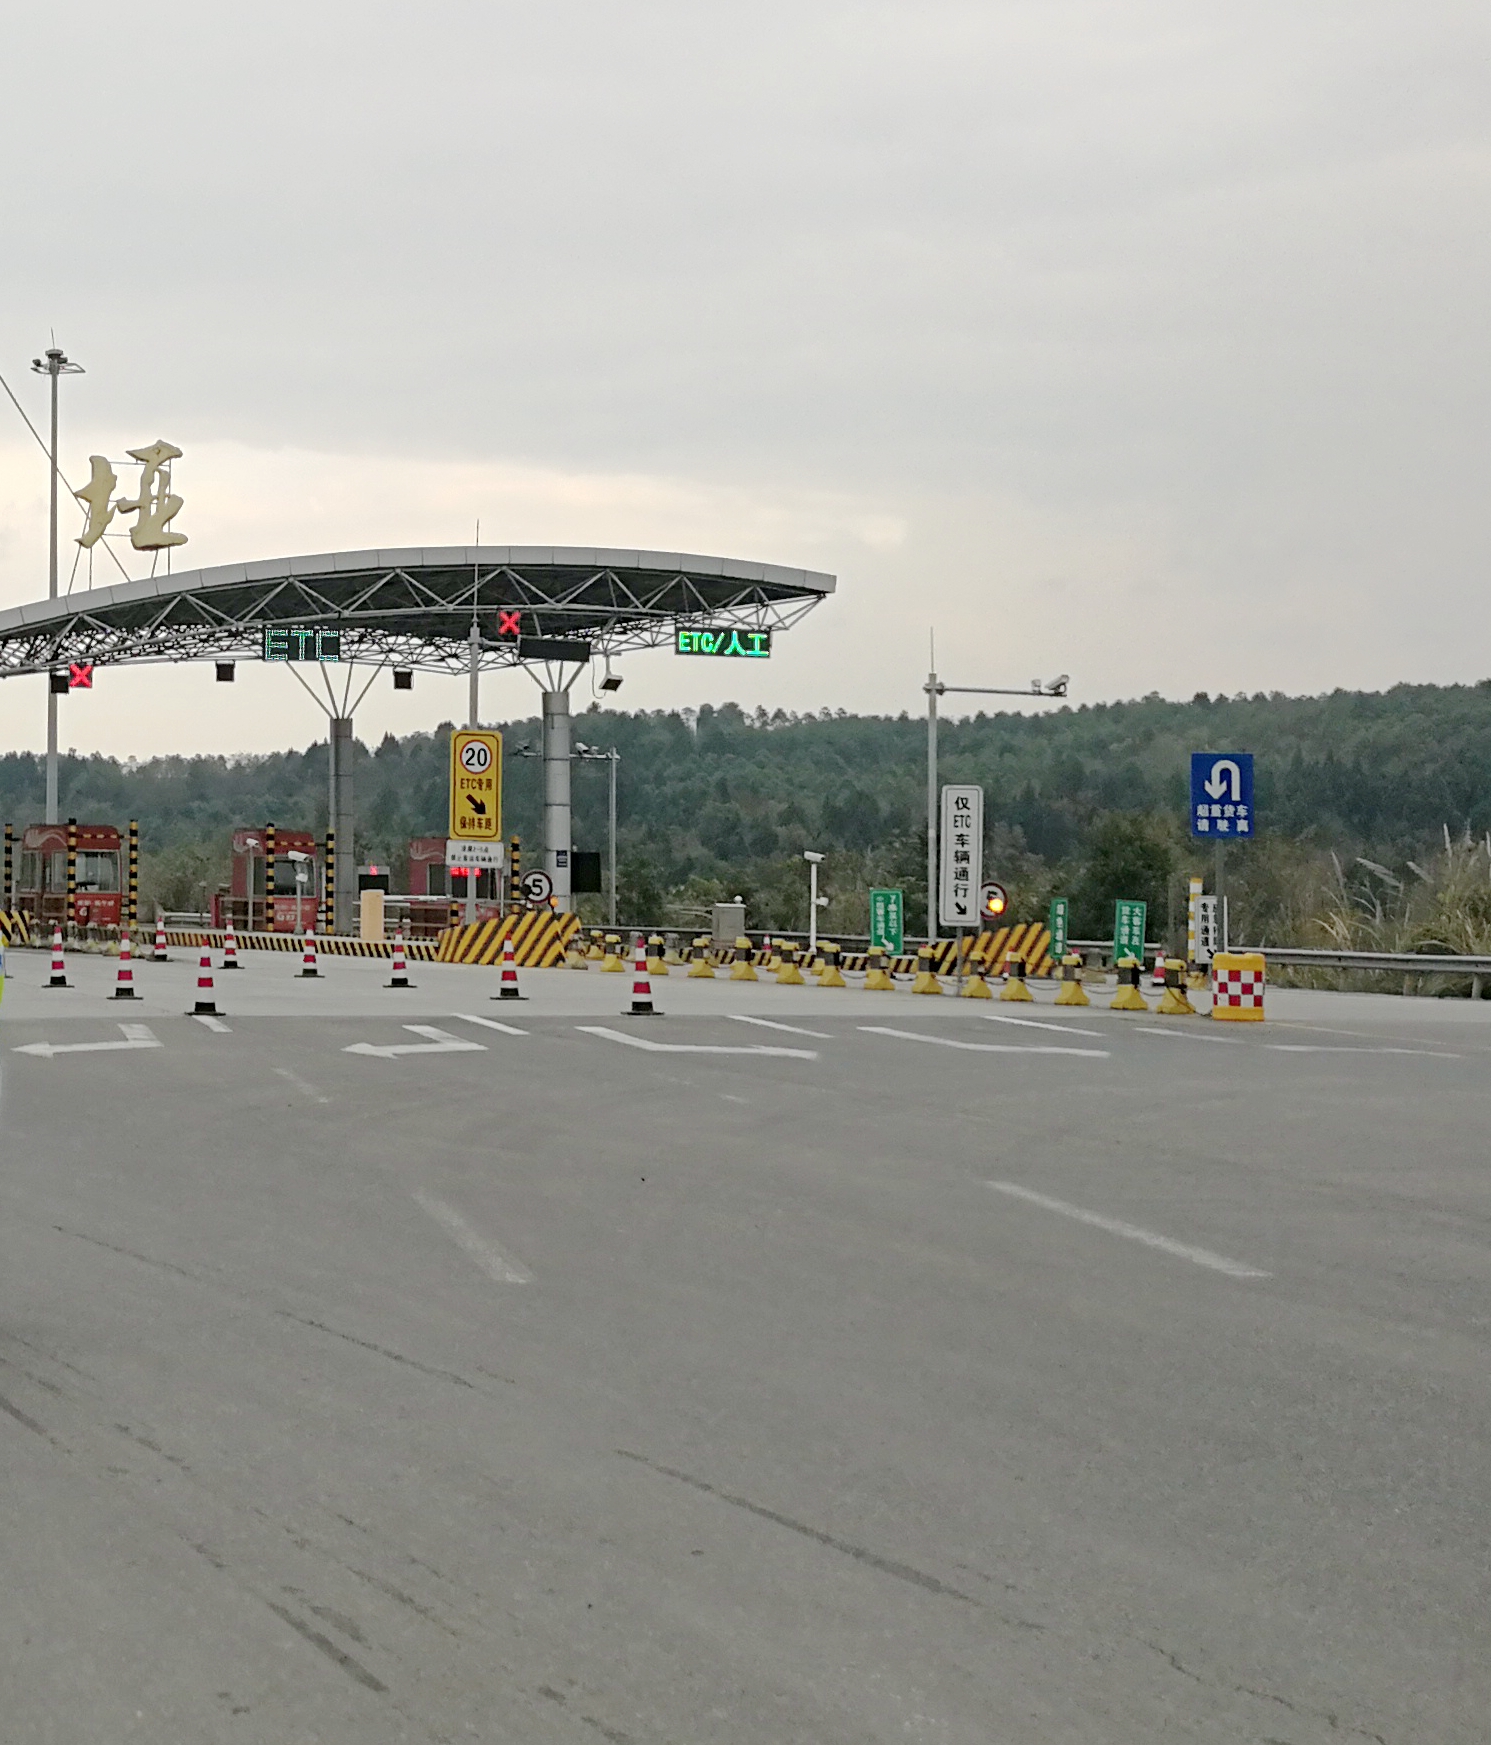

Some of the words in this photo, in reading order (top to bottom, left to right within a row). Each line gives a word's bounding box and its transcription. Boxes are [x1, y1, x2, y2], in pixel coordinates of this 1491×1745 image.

[265, 629, 338, 662] ETC
[679, 630, 769, 657] ETC/人工
[465, 748, 487, 766] 20
[460, 778, 492, 791] ETC专用
[460, 816, 492, 830] 保持车距
[953, 796, 971, 898] 仅ETC车辆通行
[531, 879, 544, 896] 5
